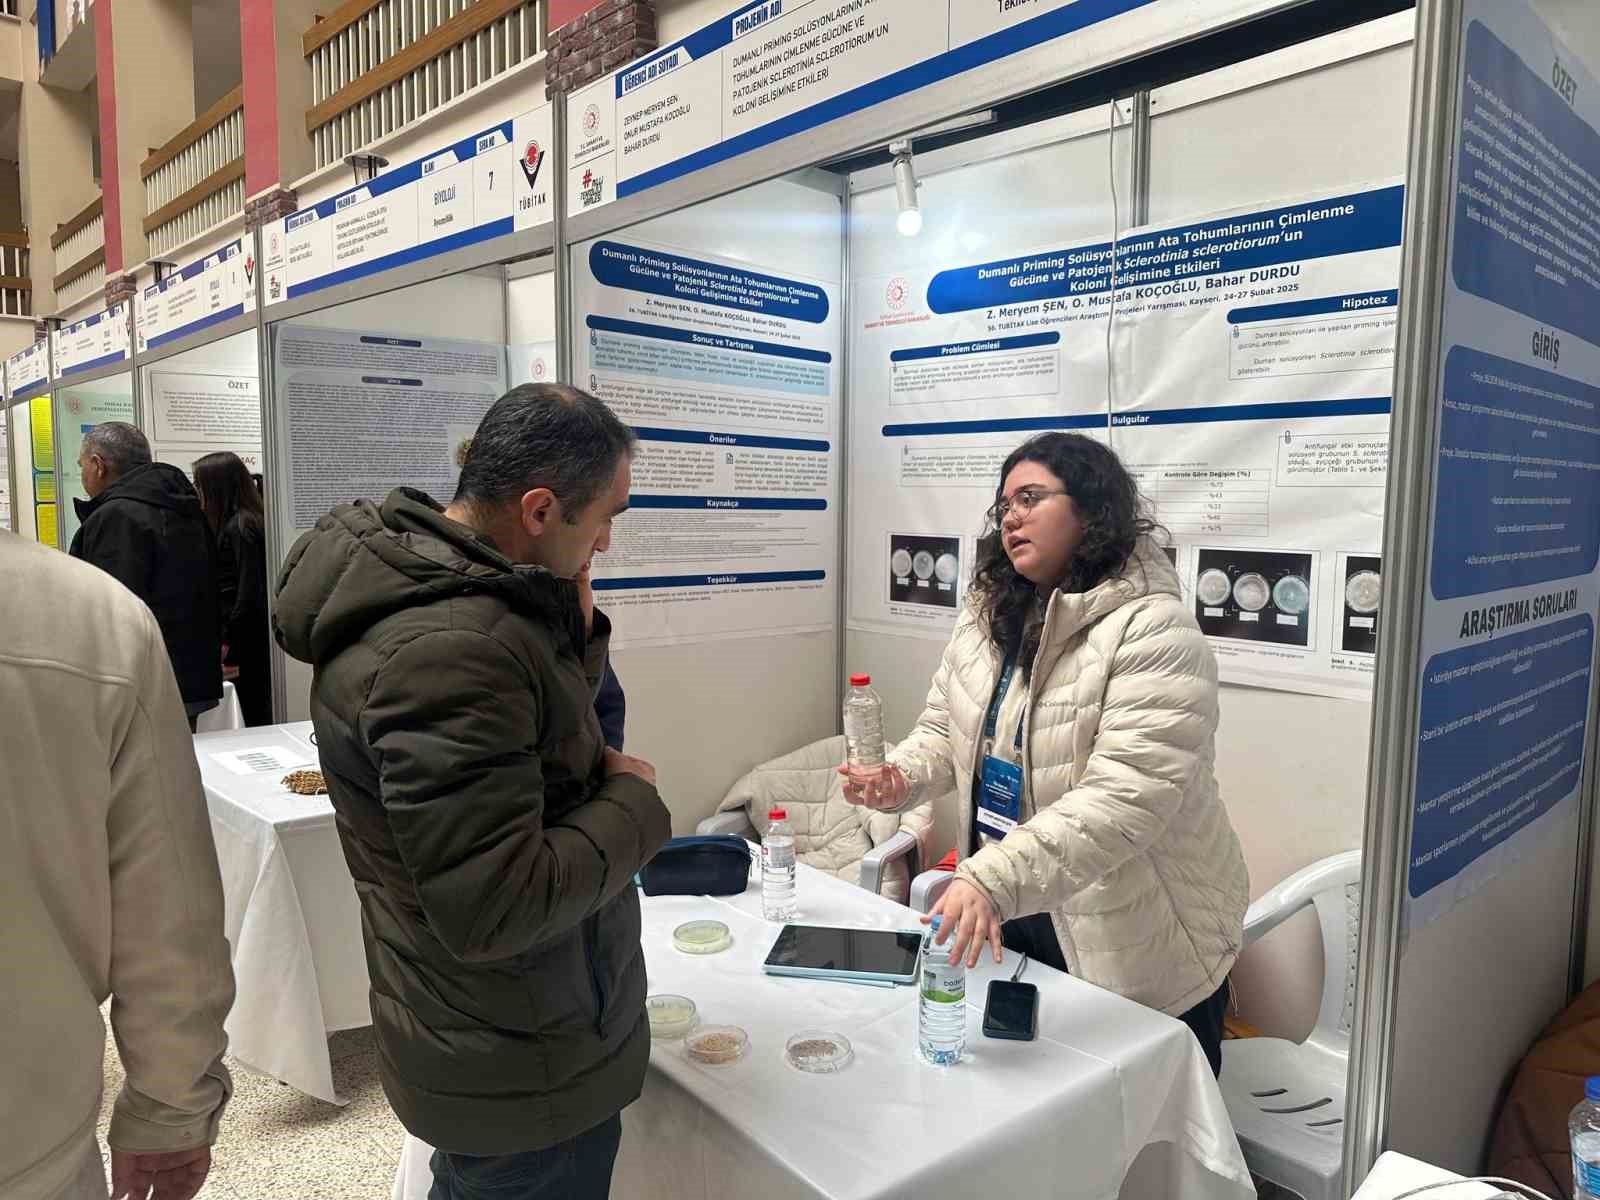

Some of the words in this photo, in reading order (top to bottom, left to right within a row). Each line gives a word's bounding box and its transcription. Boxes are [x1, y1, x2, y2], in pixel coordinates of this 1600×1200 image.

[854, 15, 865, 28] VE
[1552, 57, 1578, 106] ÖZET
[488, 171, 494, 191] 7
[520, 192, 546, 211] TÜBİTAK
[978, 266, 1019, 280] Dumanlı
[1023, 257, 1065, 273] Priming
[1068, 240, 1154, 265] Solüsyonlarının
[1158, 235, 1180, 248] Ata
[1183, 219, 1274, 243] Tohumlarının
[1278, 203, 1355, 228] Çimlenme
[1010, 272, 1049, 288] Gücüne
[1052, 272, 1065, 281] ve
[1124, 249, 1189, 270] Sclerotinia
[1192, 230, 1303, 256] sclerotiorum'un
[602, 248, 637, 262] Dumanlı
[639, 255, 670, 271] Priming
[672, 262, 729, 280] Solüsyonlarının
[730, 275, 742, 284] Ata
[744, 278, 787, 293] Tohumlarının
[788, 287, 820, 300] Çimlenme
[629, 264, 660, 278] Gücüne
[662, 272, 672, 280] ve
[673, 273, 708, 288] Patojenik
[1070, 276, 1107, 292] Koloni
[1110, 267, 1171, 286] Gelişimine
[1174, 257, 1220, 276] Etkileri
[674, 283, 701, 296] Koloni
[700, 288, 738, 303] Gelişimine
[739, 296, 764, 308] Etkileri
[987, 310, 996, 319] Z.
[999, 304, 1040, 317] Meryem
[1042, 300, 1068, 313] ŞEN,
[1072, 298, 1085, 308] O.
[1136, 281, 1200, 300] KOÇOĞLU,
[1205, 275, 1246, 289] Bahar
[1249, 264, 1301, 283] DURDU
[1276, 283, 1299, 294] 2025
[1342, 295, 1388, 308] Hipotez
[692, 334, 714, 346] Sonuç
[715, 338, 724, 346] ve
[725, 338, 754, 351] Tartışma
[942, 344, 970, 355] Problem
[1531, 328, 1560, 369] GİRİŞ
[1112, 414, 1150, 425] Bulgular
[709, 433, 737, 445] Öneriler
[706, 499, 739, 511] Kaynakça
[1459, 602, 1530, 640] ARAŞTIRMA
[1532, 588, 1578, 621] SORULARI
